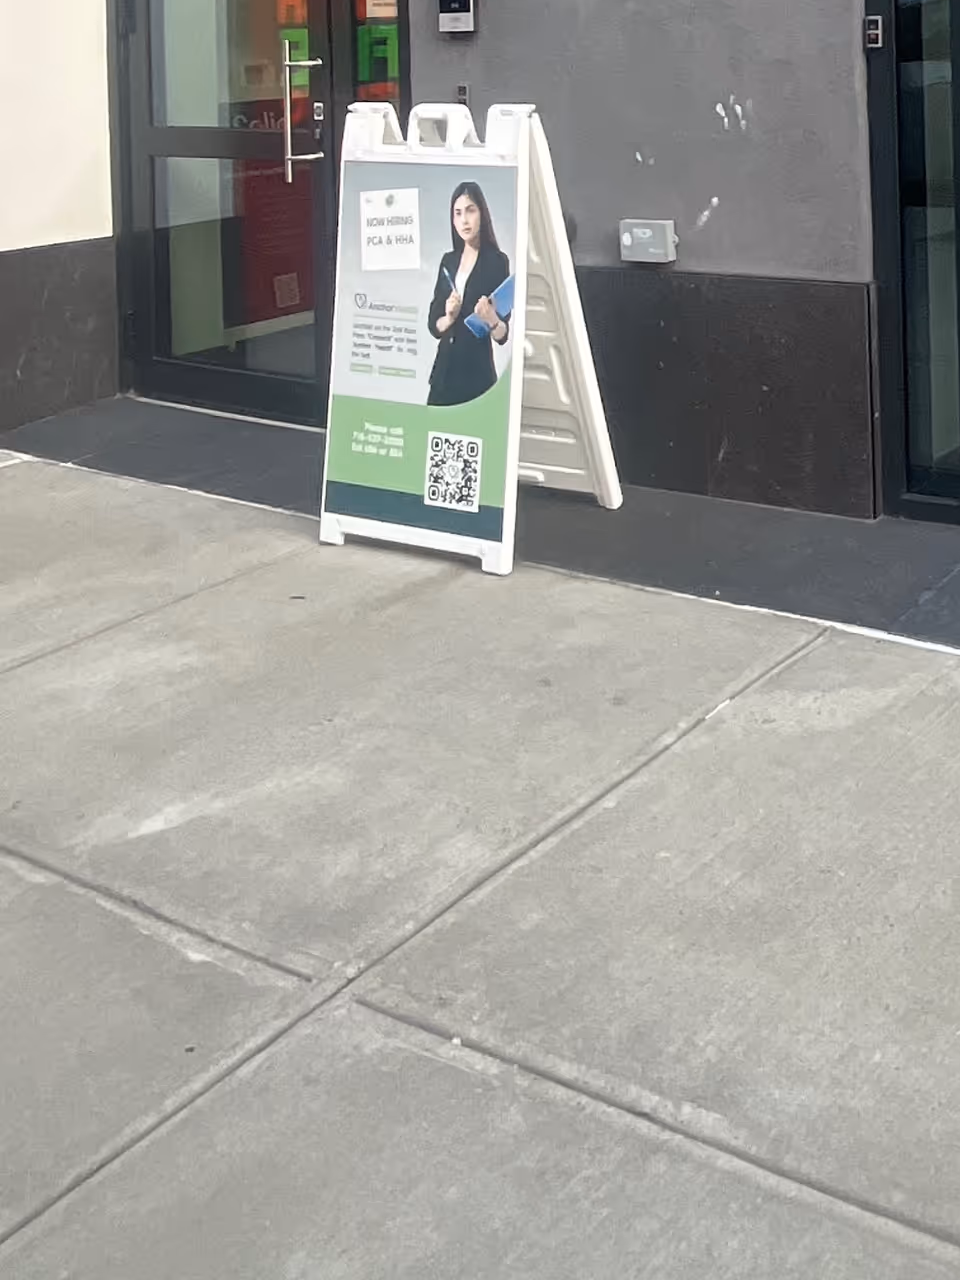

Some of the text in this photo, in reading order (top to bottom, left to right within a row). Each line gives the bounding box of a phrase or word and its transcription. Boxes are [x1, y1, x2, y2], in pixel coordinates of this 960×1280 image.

[366, 215, 413, 227] NOW HIRING
[367, 234, 414, 246] PCA & HHA
